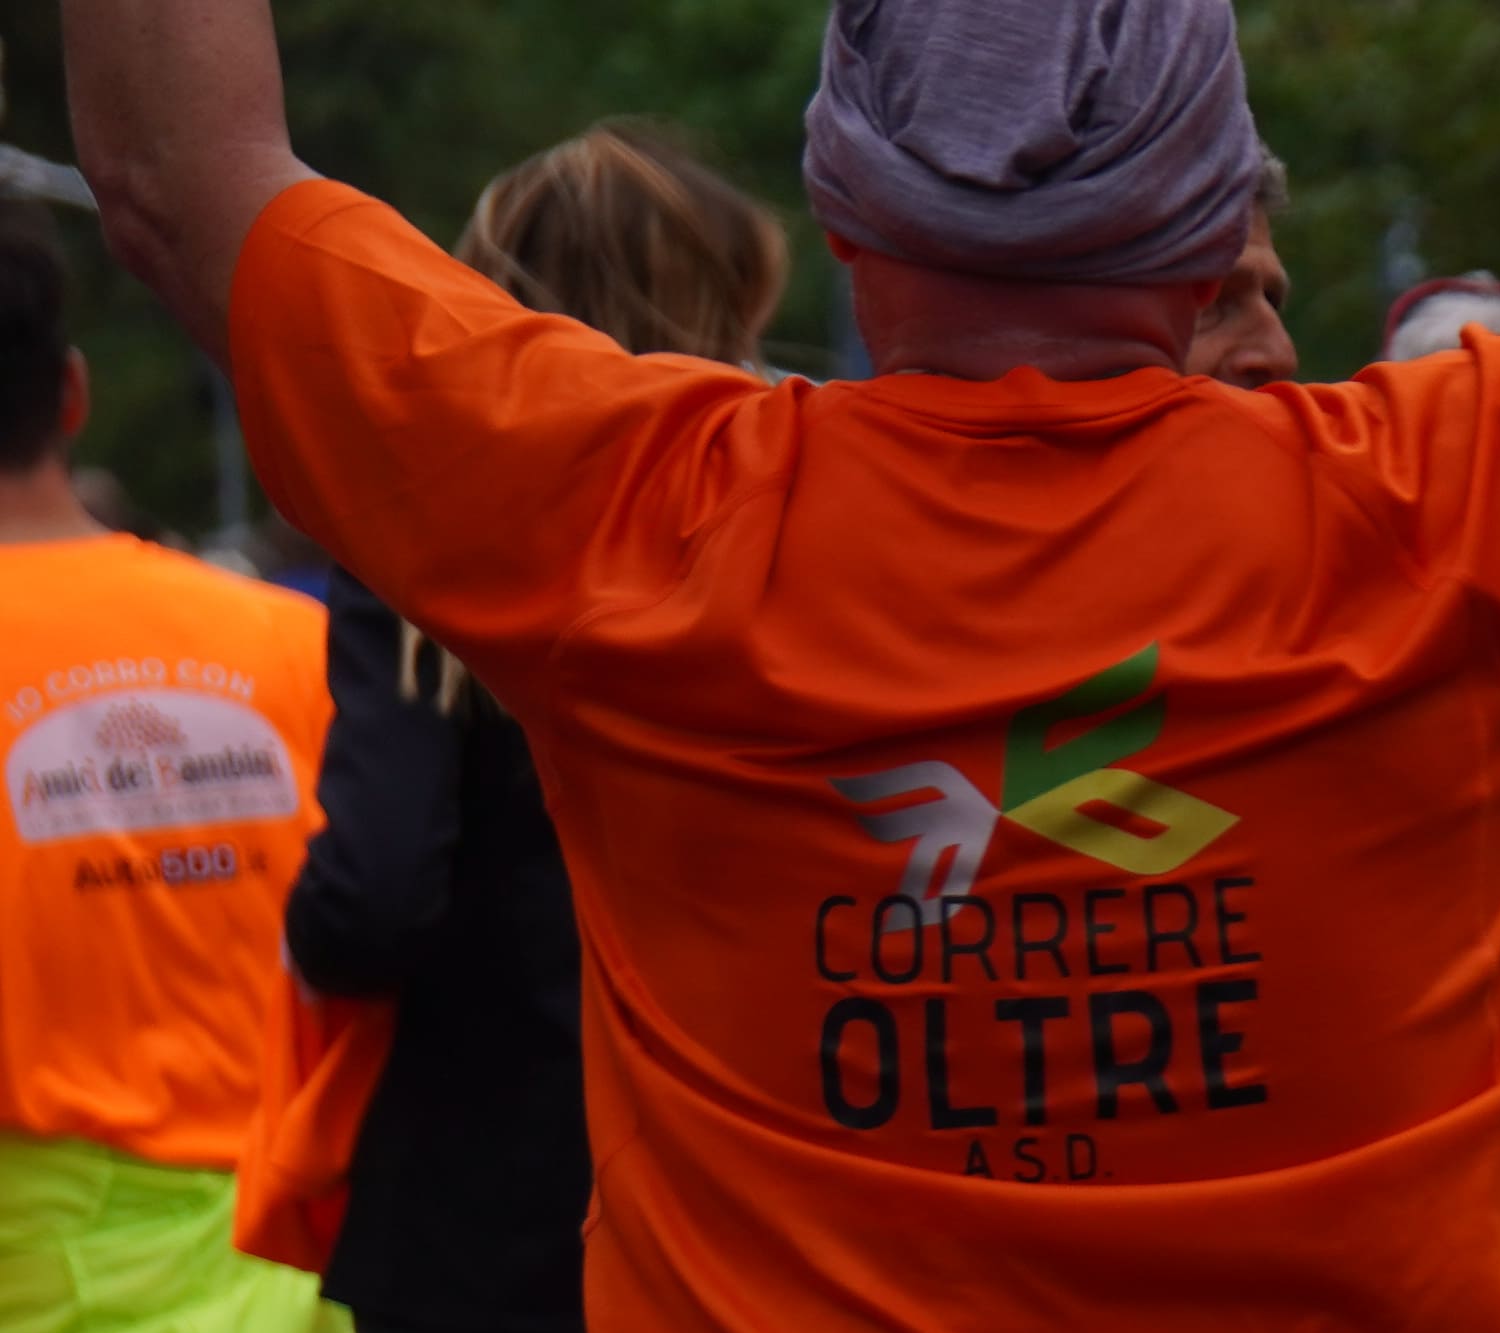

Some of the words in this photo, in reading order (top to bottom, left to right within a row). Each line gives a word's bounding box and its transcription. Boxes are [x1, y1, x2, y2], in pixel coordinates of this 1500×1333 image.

[45, 657, 167, 698] CORRO
[176, 658, 255, 701] CON
[22, 754, 102, 809] Amici
[106, 748, 154, 793] dei
[155, 738, 283, 792] Bambini
[813, 876, 1262, 985] CORRERE
[819, 979, 1268, 1131] OLTRE
